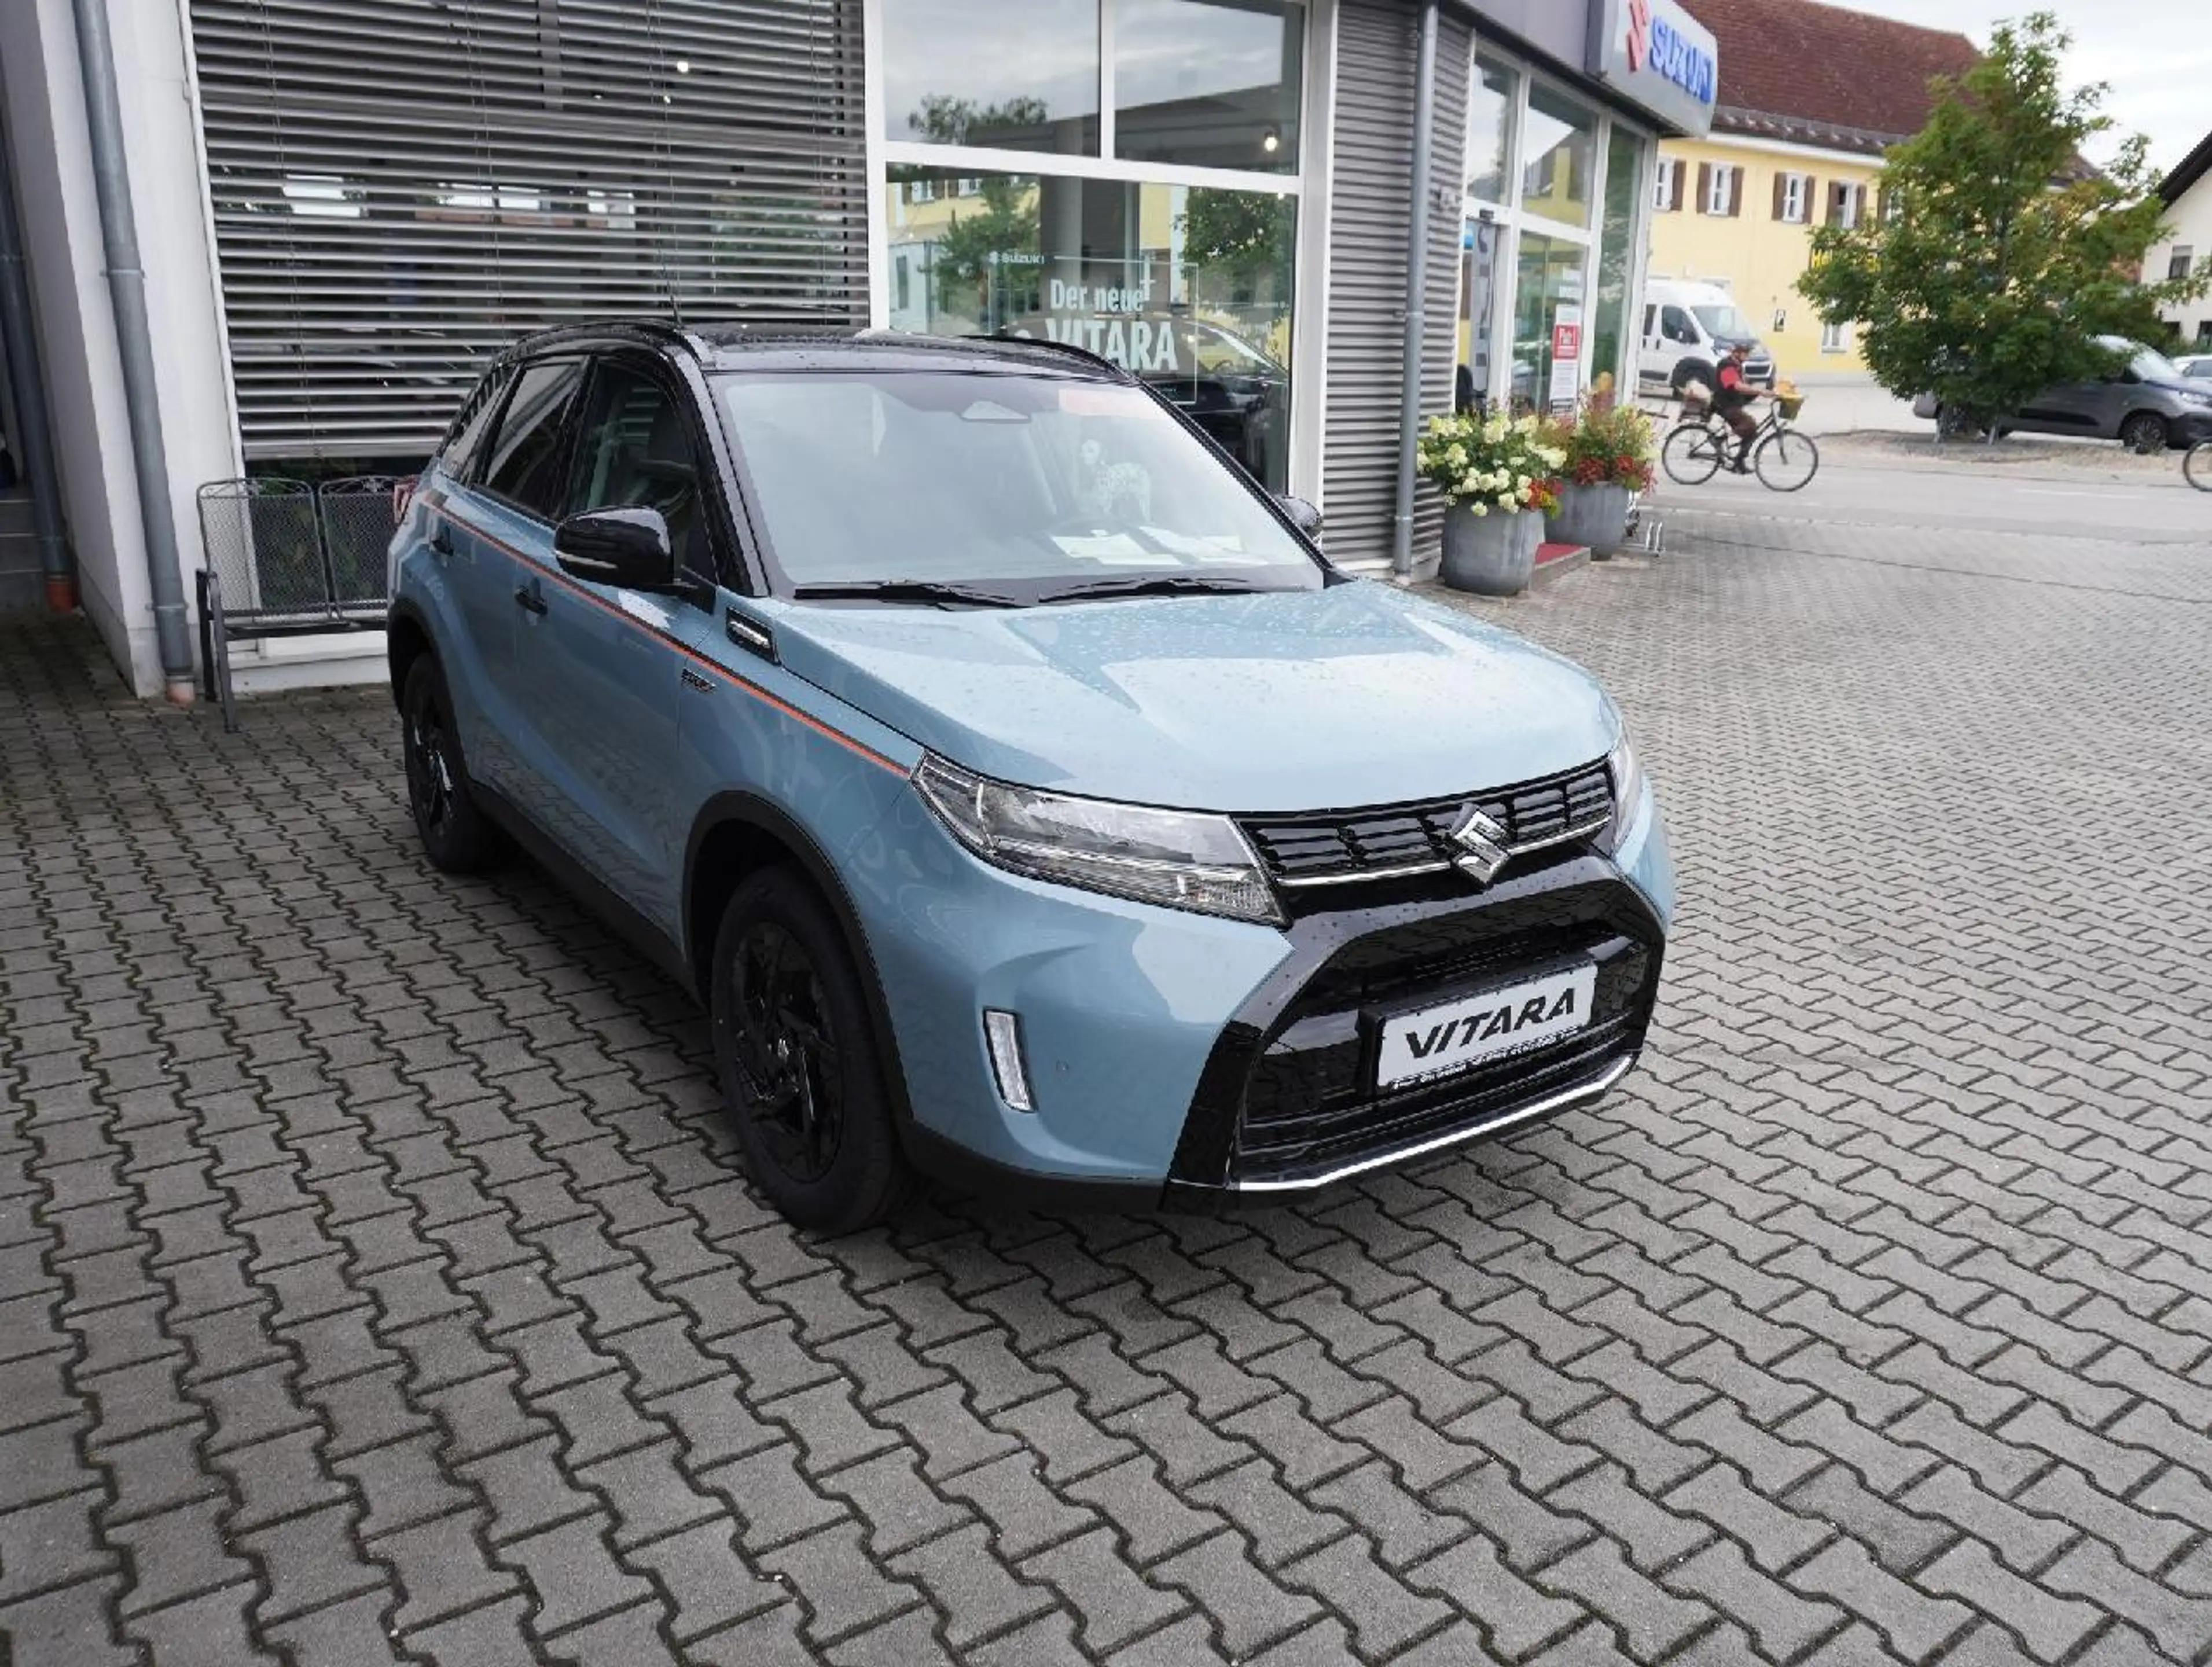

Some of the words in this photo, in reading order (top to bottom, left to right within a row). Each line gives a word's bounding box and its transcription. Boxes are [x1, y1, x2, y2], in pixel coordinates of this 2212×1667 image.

[1649, 16, 1714, 105] SUZUKI
[1050, 279, 1087, 311] Der
[1094, 287, 1144, 312] neue
[1406, 987, 1575, 1059] VITARA
